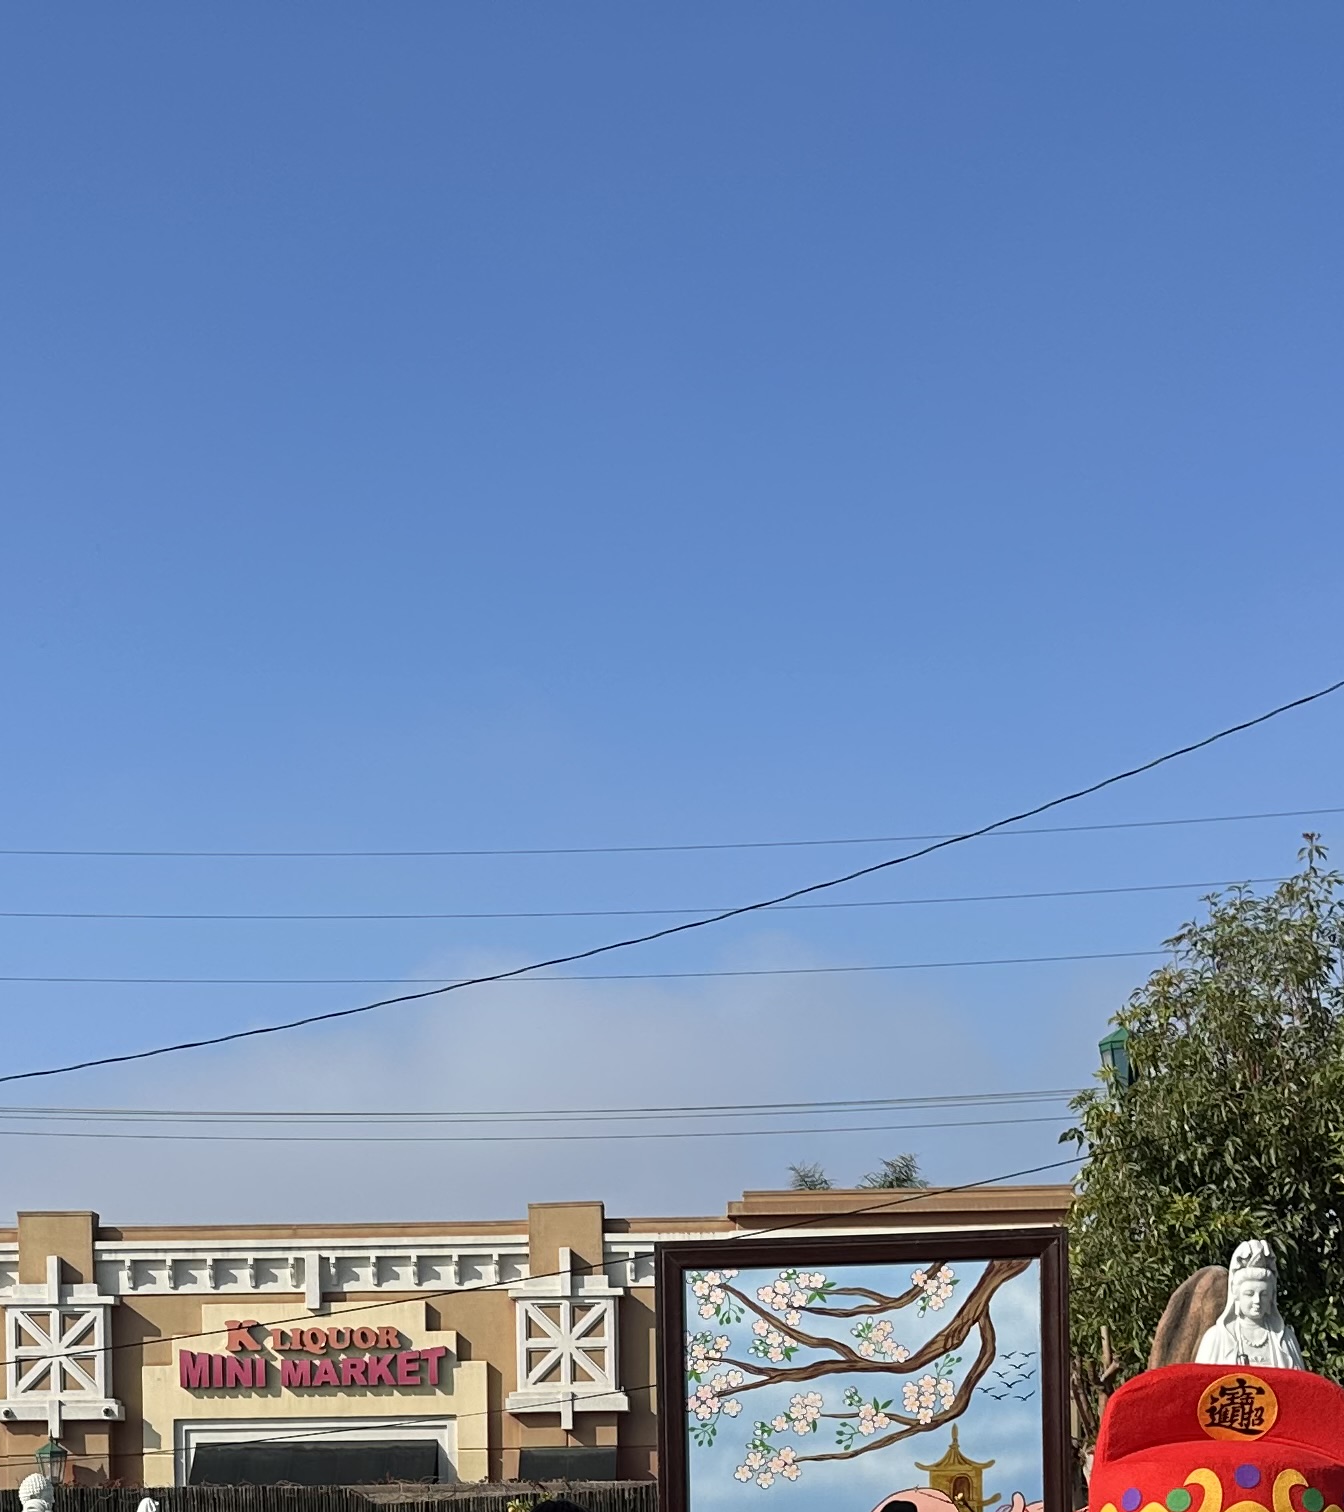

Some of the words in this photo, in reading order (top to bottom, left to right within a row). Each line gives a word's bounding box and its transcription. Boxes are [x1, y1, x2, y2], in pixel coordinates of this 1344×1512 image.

[224, 1319, 261, 1351] K
[270, 1326, 401, 1355] LIQUOR
[179, 1349, 267, 1388] MINI
[281, 1346, 446, 1388] MARKET
